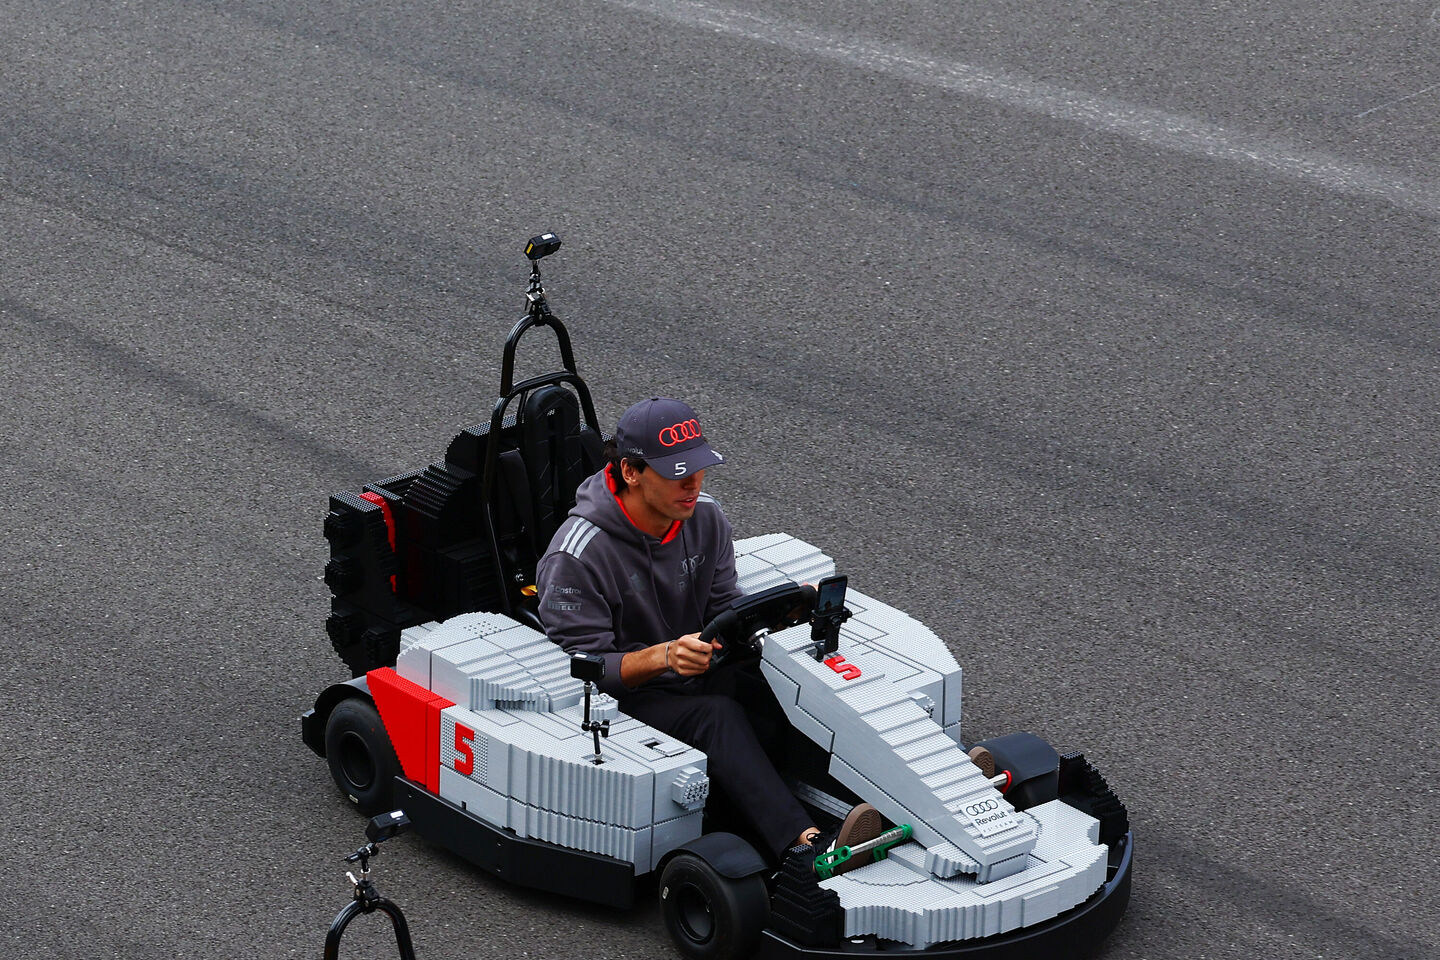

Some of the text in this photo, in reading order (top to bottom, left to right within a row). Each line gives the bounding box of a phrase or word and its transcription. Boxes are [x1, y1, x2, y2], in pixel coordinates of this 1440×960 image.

[674, 462, 687, 476] 5
[824, 655, 862, 681] 5
[454, 722, 475, 776] 5
[974, 811, 1008, 826] Revolut
